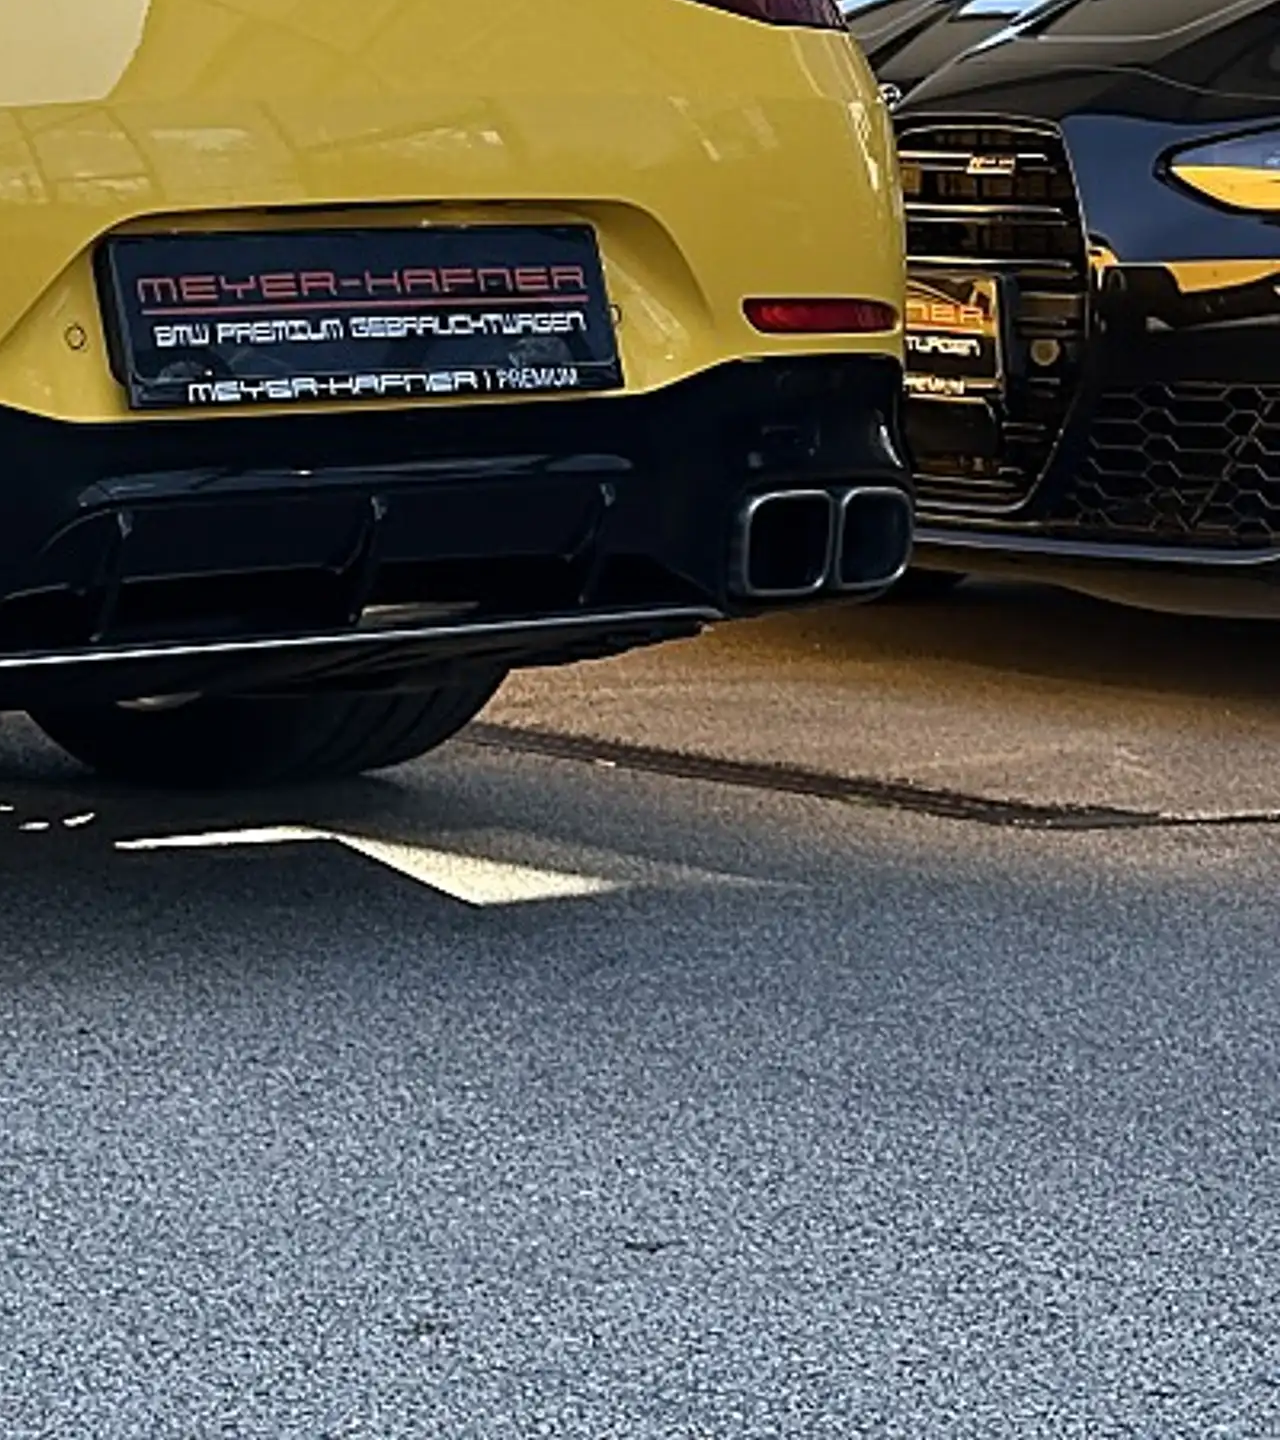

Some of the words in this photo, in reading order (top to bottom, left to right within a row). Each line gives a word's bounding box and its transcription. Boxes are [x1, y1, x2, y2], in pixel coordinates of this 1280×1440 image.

[136, 264, 588, 304] MEYER-HAFNER
[153, 323, 210, 348] BMW
[216, 317, 344, 345] PREMIUM
[349, 311, 587, 338] GEBRAUCHTWAGEN
[187, 370, 479, 404] MEYER-HAFNER
[496, 366, 578, 390] PREMIUM
